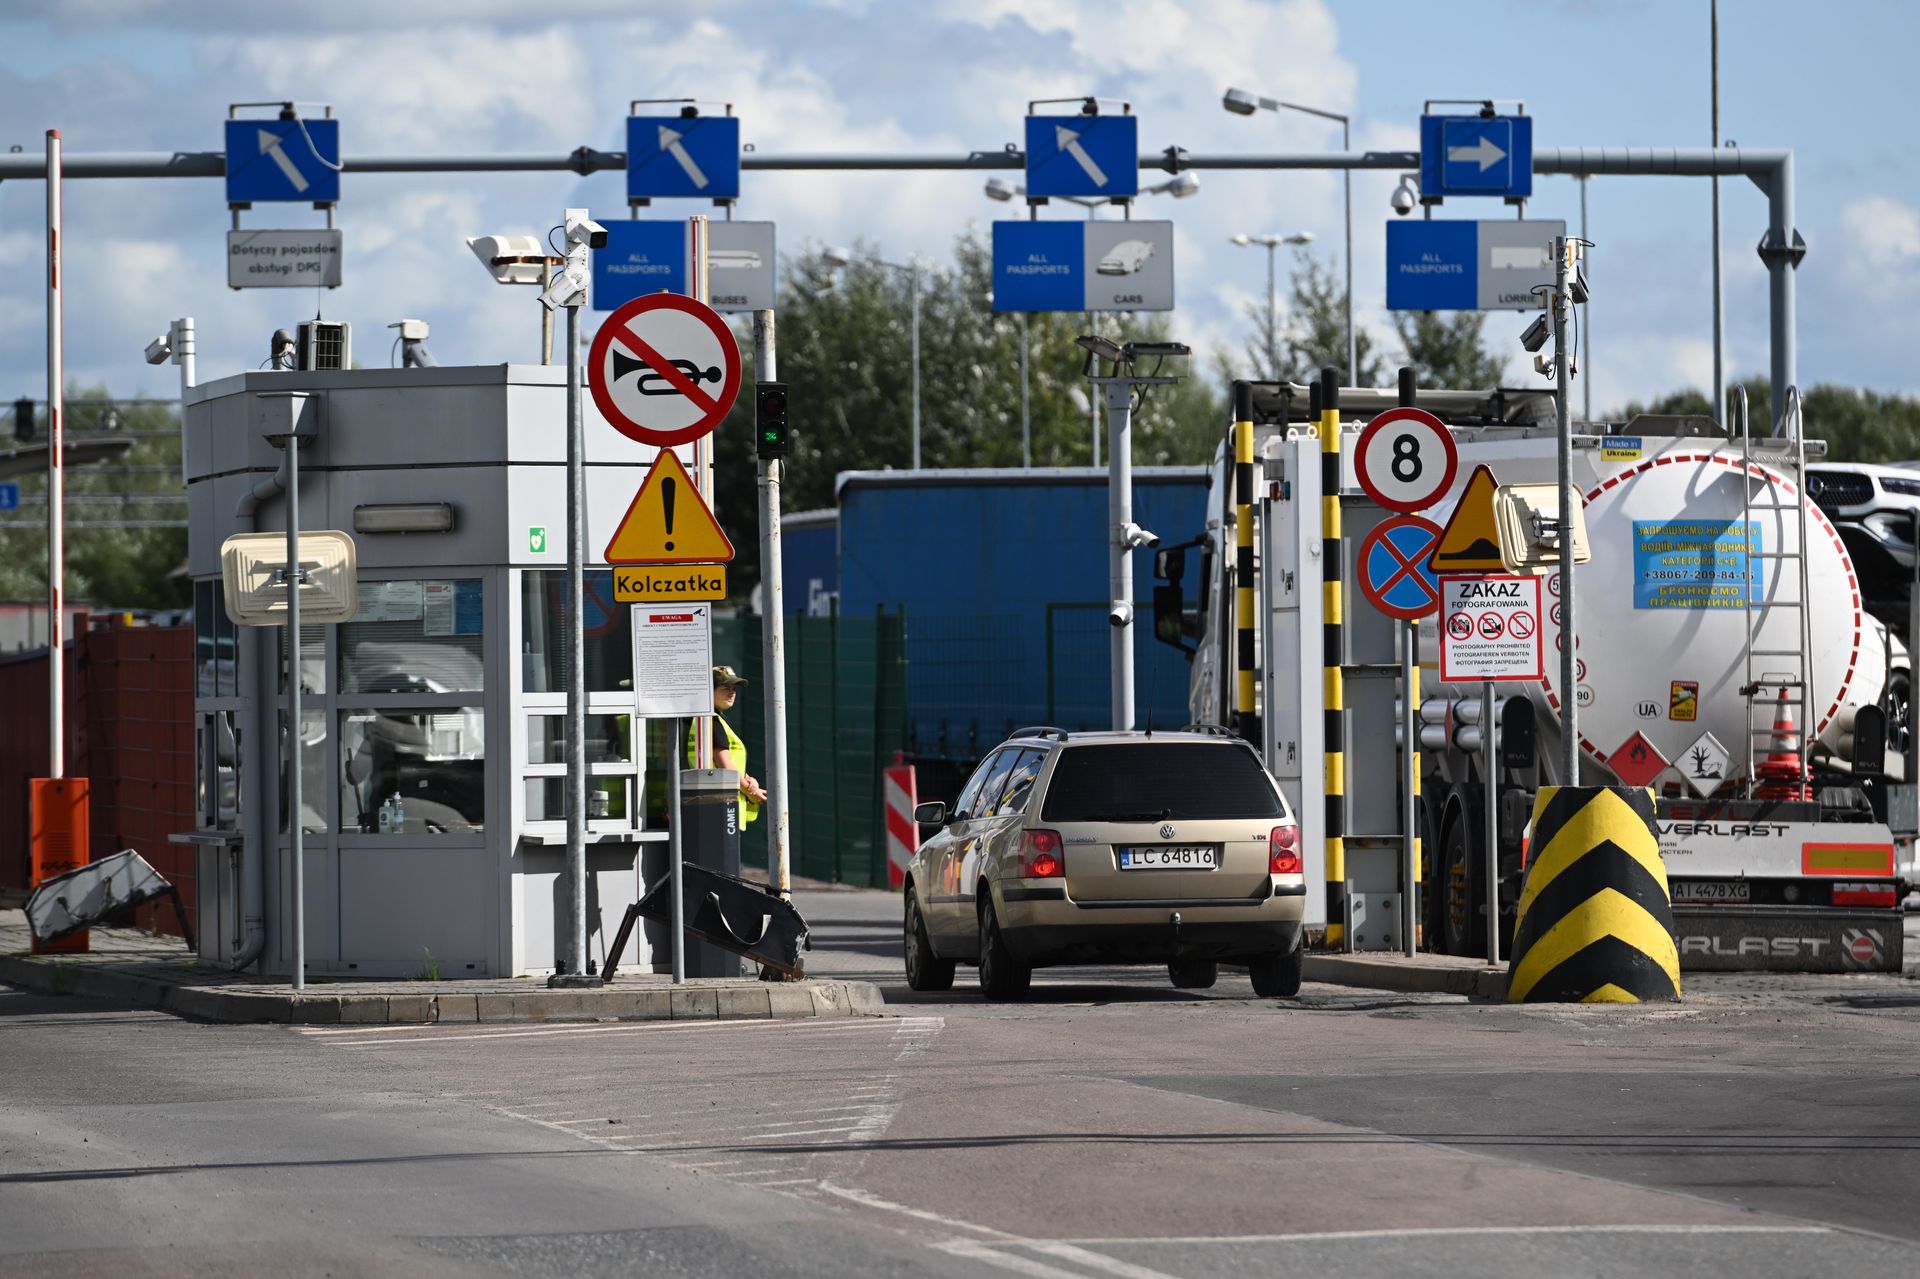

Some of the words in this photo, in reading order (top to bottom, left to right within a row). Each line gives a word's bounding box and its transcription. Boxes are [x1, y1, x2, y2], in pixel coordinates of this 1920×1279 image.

[628, 253, 649, 263] ALL
[1028, 254, 1048, 263] ALL
[1421, 252, 1442, 263] ALL
[607, 264, 671, 275] PASSPORTS
[1007, 264, 1070, 275] PASSPORTS
[1400, 264, 1463, 274] PASSPORTS
[712, 295, 748, 305] BUSES
[1114, 295, 1144, 304] CARS
[1607, 439, 1629, 448] Made
[1631, 440, 1638, 448] in
[1391, 433, 1423, 483] 8
[1606, 449, 1637, 457] Ukraine
[1707, 526, 1718, 535] НА
[1722, 526, 1758, 536] РОБОУ
[1677, 542, 1756, 553] МІЖНАРОДНИКВ
[617, 575, 722, 594] Kolczatka
[1460, 583, 1520, 598] ZAKAZ
[1451, 600, 1529, 609] FOTOGRAFOWANIA
[1639, 703, 1657, 716] UA
[727, 807, 736, 835] CAME
[1657, 822, 1790, 837] VERLAST
[1132, 848, 1155, 865] LC
[1161, 847, 1212, 864] 64816
[1676, 884, 1691, 897] AI
[1695, 884, 1726, 897] 4478
[1728, 884, 1748, 898] XG
[1676, 936, 1831, 957] RLAST
